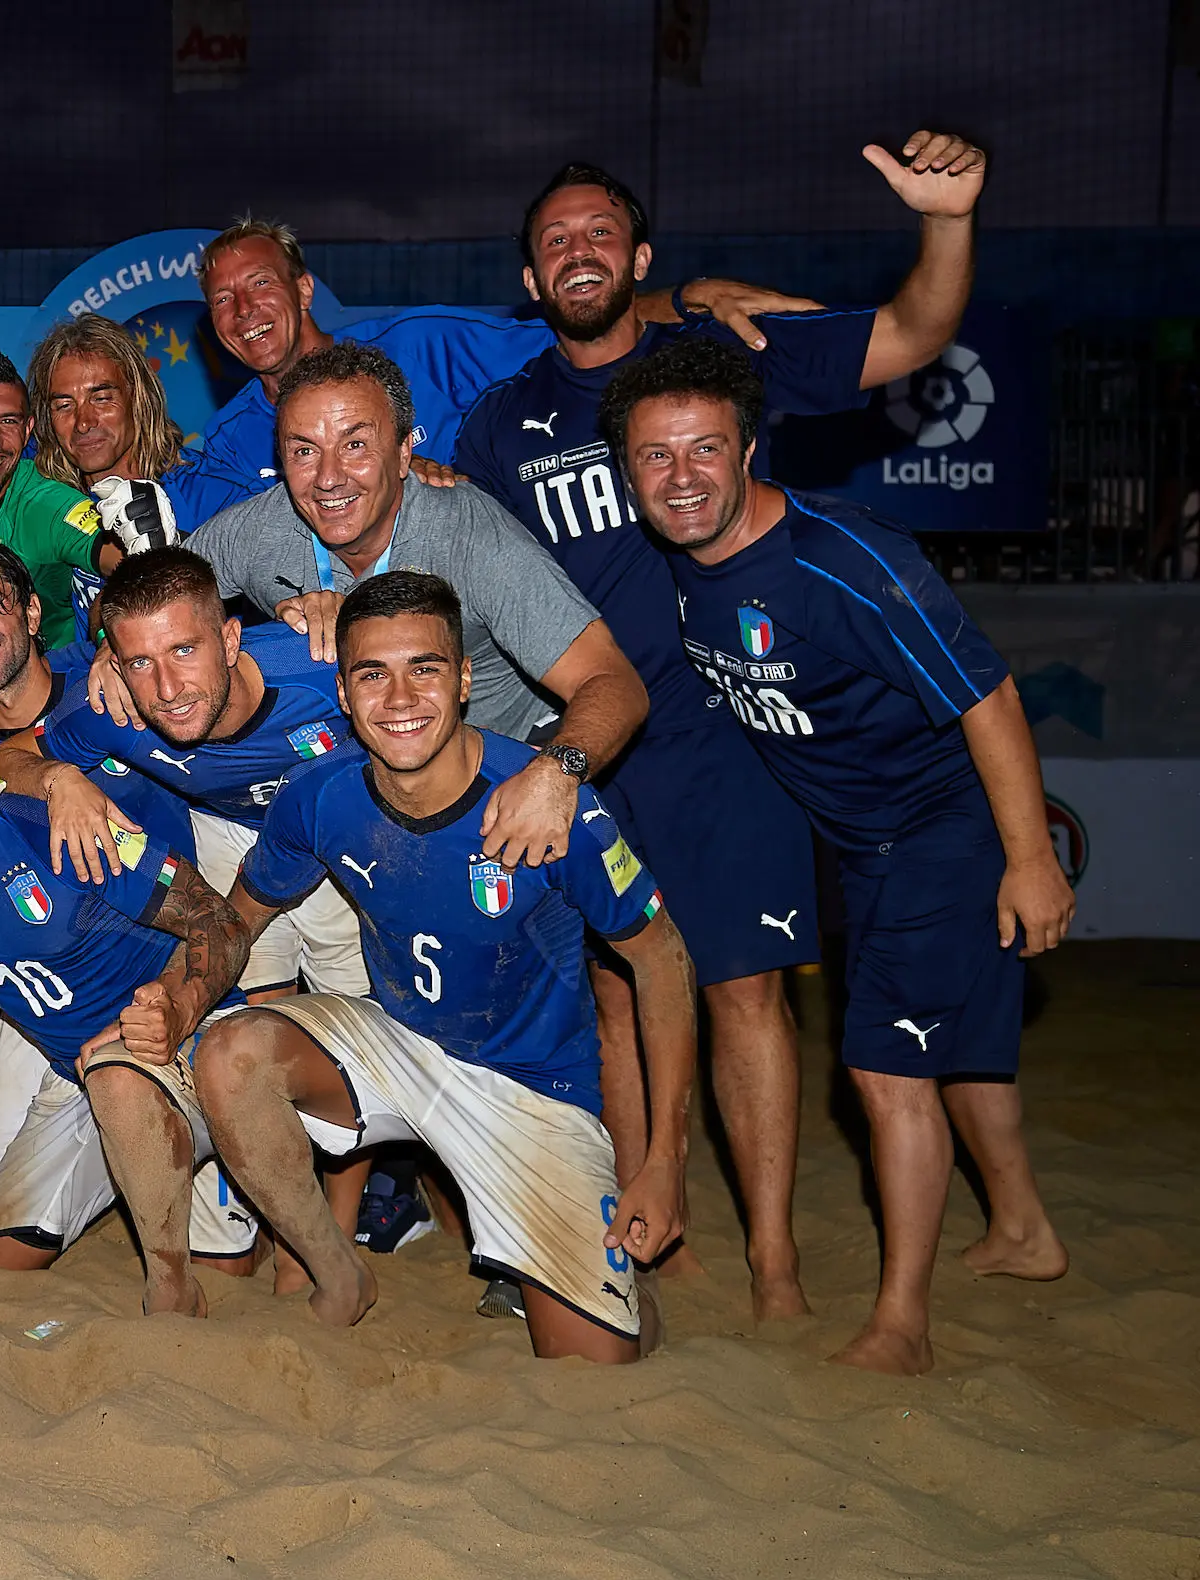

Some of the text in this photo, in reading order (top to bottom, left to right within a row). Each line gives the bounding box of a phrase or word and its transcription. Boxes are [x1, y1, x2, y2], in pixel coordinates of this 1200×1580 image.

[67, 260, 153, 317] BEACH
[532, 457, 557, 474] TIM
[883, 453, 995, 491] LaLiga
[762, 664, 787, 679] FIAT
[293, 722, 323, 742] ITALIA
